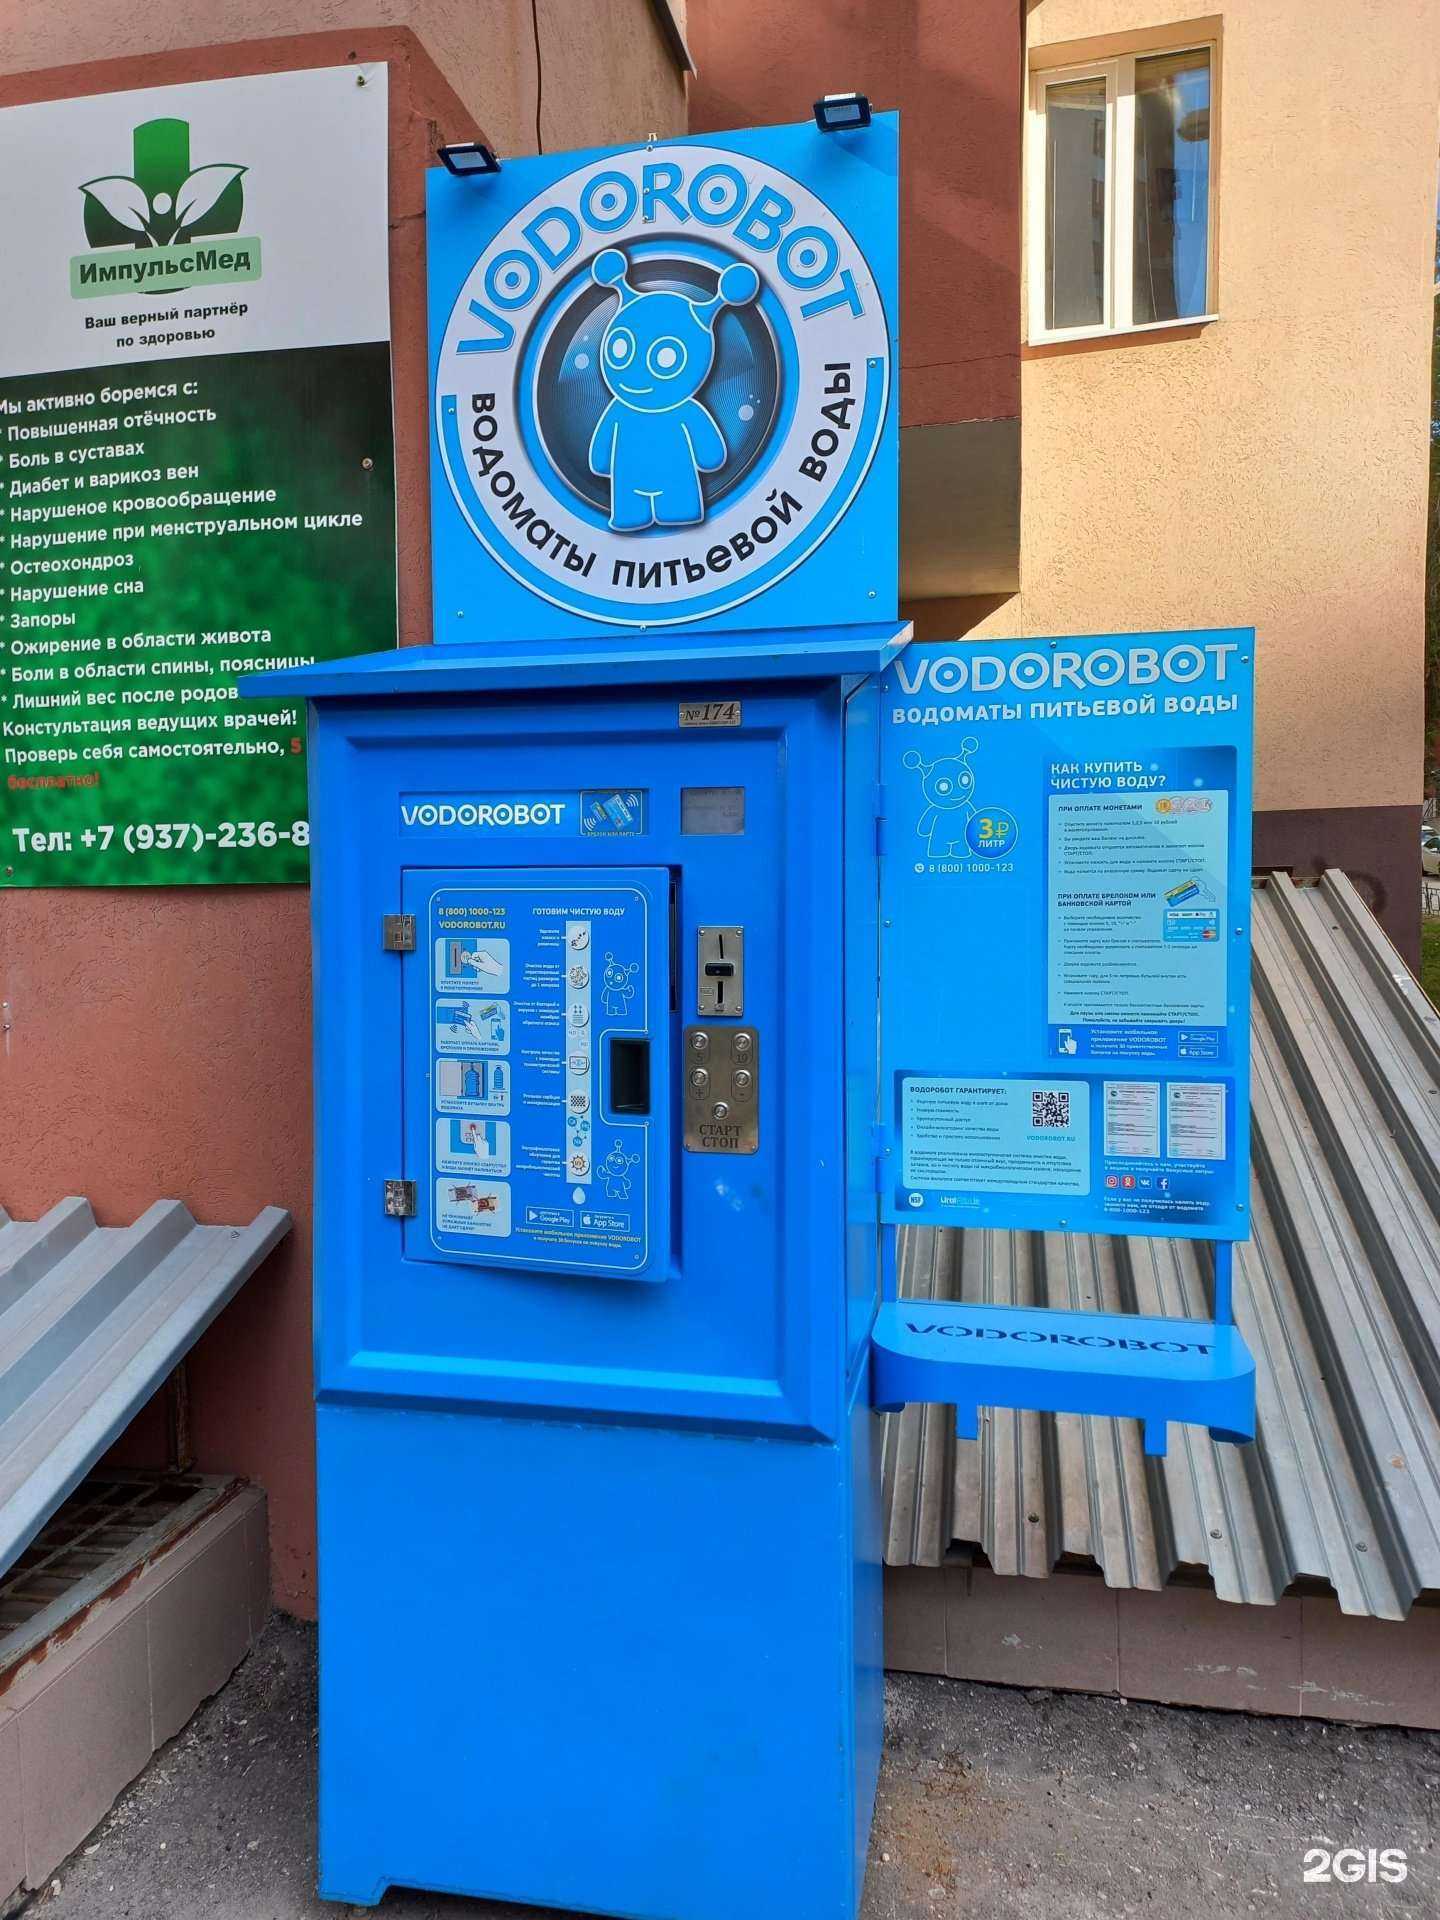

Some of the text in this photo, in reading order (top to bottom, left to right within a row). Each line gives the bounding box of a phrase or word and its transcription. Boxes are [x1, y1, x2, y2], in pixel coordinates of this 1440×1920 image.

[80, 250, 250, 284] ИмпульсМед
[455, 160, 867, 356] VODOROBOT
[85, 302, 248, 329] Ваш верный партнёр
[116, 328, 215, 348] по здоровью
[27, 393, 95, 412] активно
[100, 383, 177, 404] боремся
[183, 381, 198, 395] с:
[8, 407, 216, 442] Повышенная отёчность
[9, 442, 144, 469] Боль в суставах
[9, 465, 199, 499] Диабет и варикоз вен
[10, 486, 277, 524] Нарушеное кровообращение
[10, 511, 363, 550] Нарушение при менструальном цикле
[10, 552, 134, 577] Остеохондроз
[10, 578, 144, 602] Нарушение сна
[10, 613, 76, 630] Запоры
[11, 627, 271, 657] Ожирение в области живота
[11, 666, 54, 683] Боли
[59, 666, 69, 680] в
[74, 660, 146, 679] области
[151, 658, 214, 677] спины,
[893, 643, 1237, 694] VODOROBOT
[12, 690, 81, 710] Лишний
[87, 689, 116, 706] вес
[122, 686, 175, 704] после
[892, 693, 1237, 726] ВОДОМАТЫ ПИТЬЕВОЙ ВОДЫ
[3, 708, 298, 737] Констультация ведущих врачей!
[702, 703, 737, 721] 174
[5, 745, 77, 764] Проверь
[82, 740, 123, 760] себя
[128, 738, 285, 758] самостоятельно,
[1051, 761, 1142, 775] КАК КУПИТЬ
[1051, 775, 1166, 789] ЧИСТУЮ ВОДУ?
[400, 803, 566, 827] VODOROBOT
[1103, 804, 1142, 812] МОНЕТАМИ
[12, 826, 72, 852] Тел:
[80, 824, 114, 851] +7
[977, 840, 1006, 848] ЛИТР
[929, 863, 1014, 873] 8 (800) 1000-123
[532, 907, 626, 917] ГОТОВИМ ЧИСТУЮ ВОДУ
[1105, 899, 1132, 907] КАРТОЙ
[438, 921, 506, 930] VODOROBOT.RU
[955, 1087, 1007, 1095] ГАРАНТИРУЕТ:
[699, 1125, 742, 1137] СТАРТ
[702, 1137, 738, 1149] СТОП
[906, 1322, 1216, 1355] VODOROBOT
